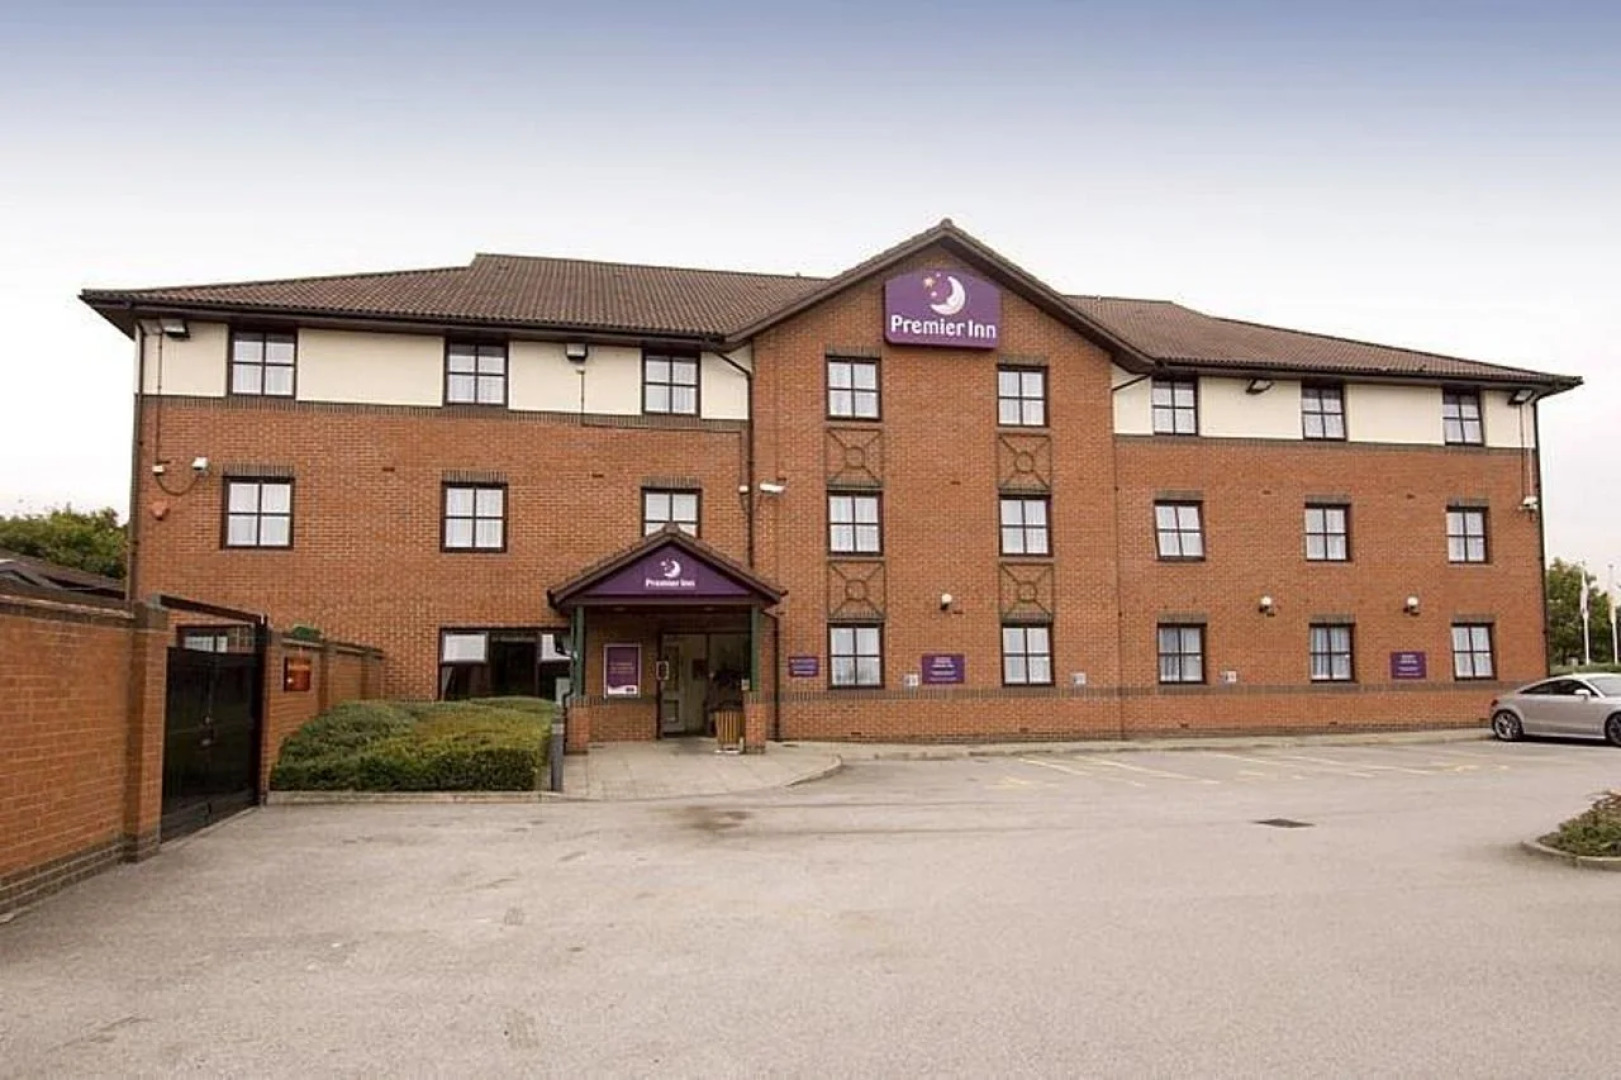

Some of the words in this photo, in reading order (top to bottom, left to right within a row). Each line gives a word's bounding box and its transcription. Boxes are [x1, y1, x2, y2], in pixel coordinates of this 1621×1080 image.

[891, 315, 965, 336] Premier
[968, 319, 997, 339] Inn
[645, 578, 680, 588] Premier
